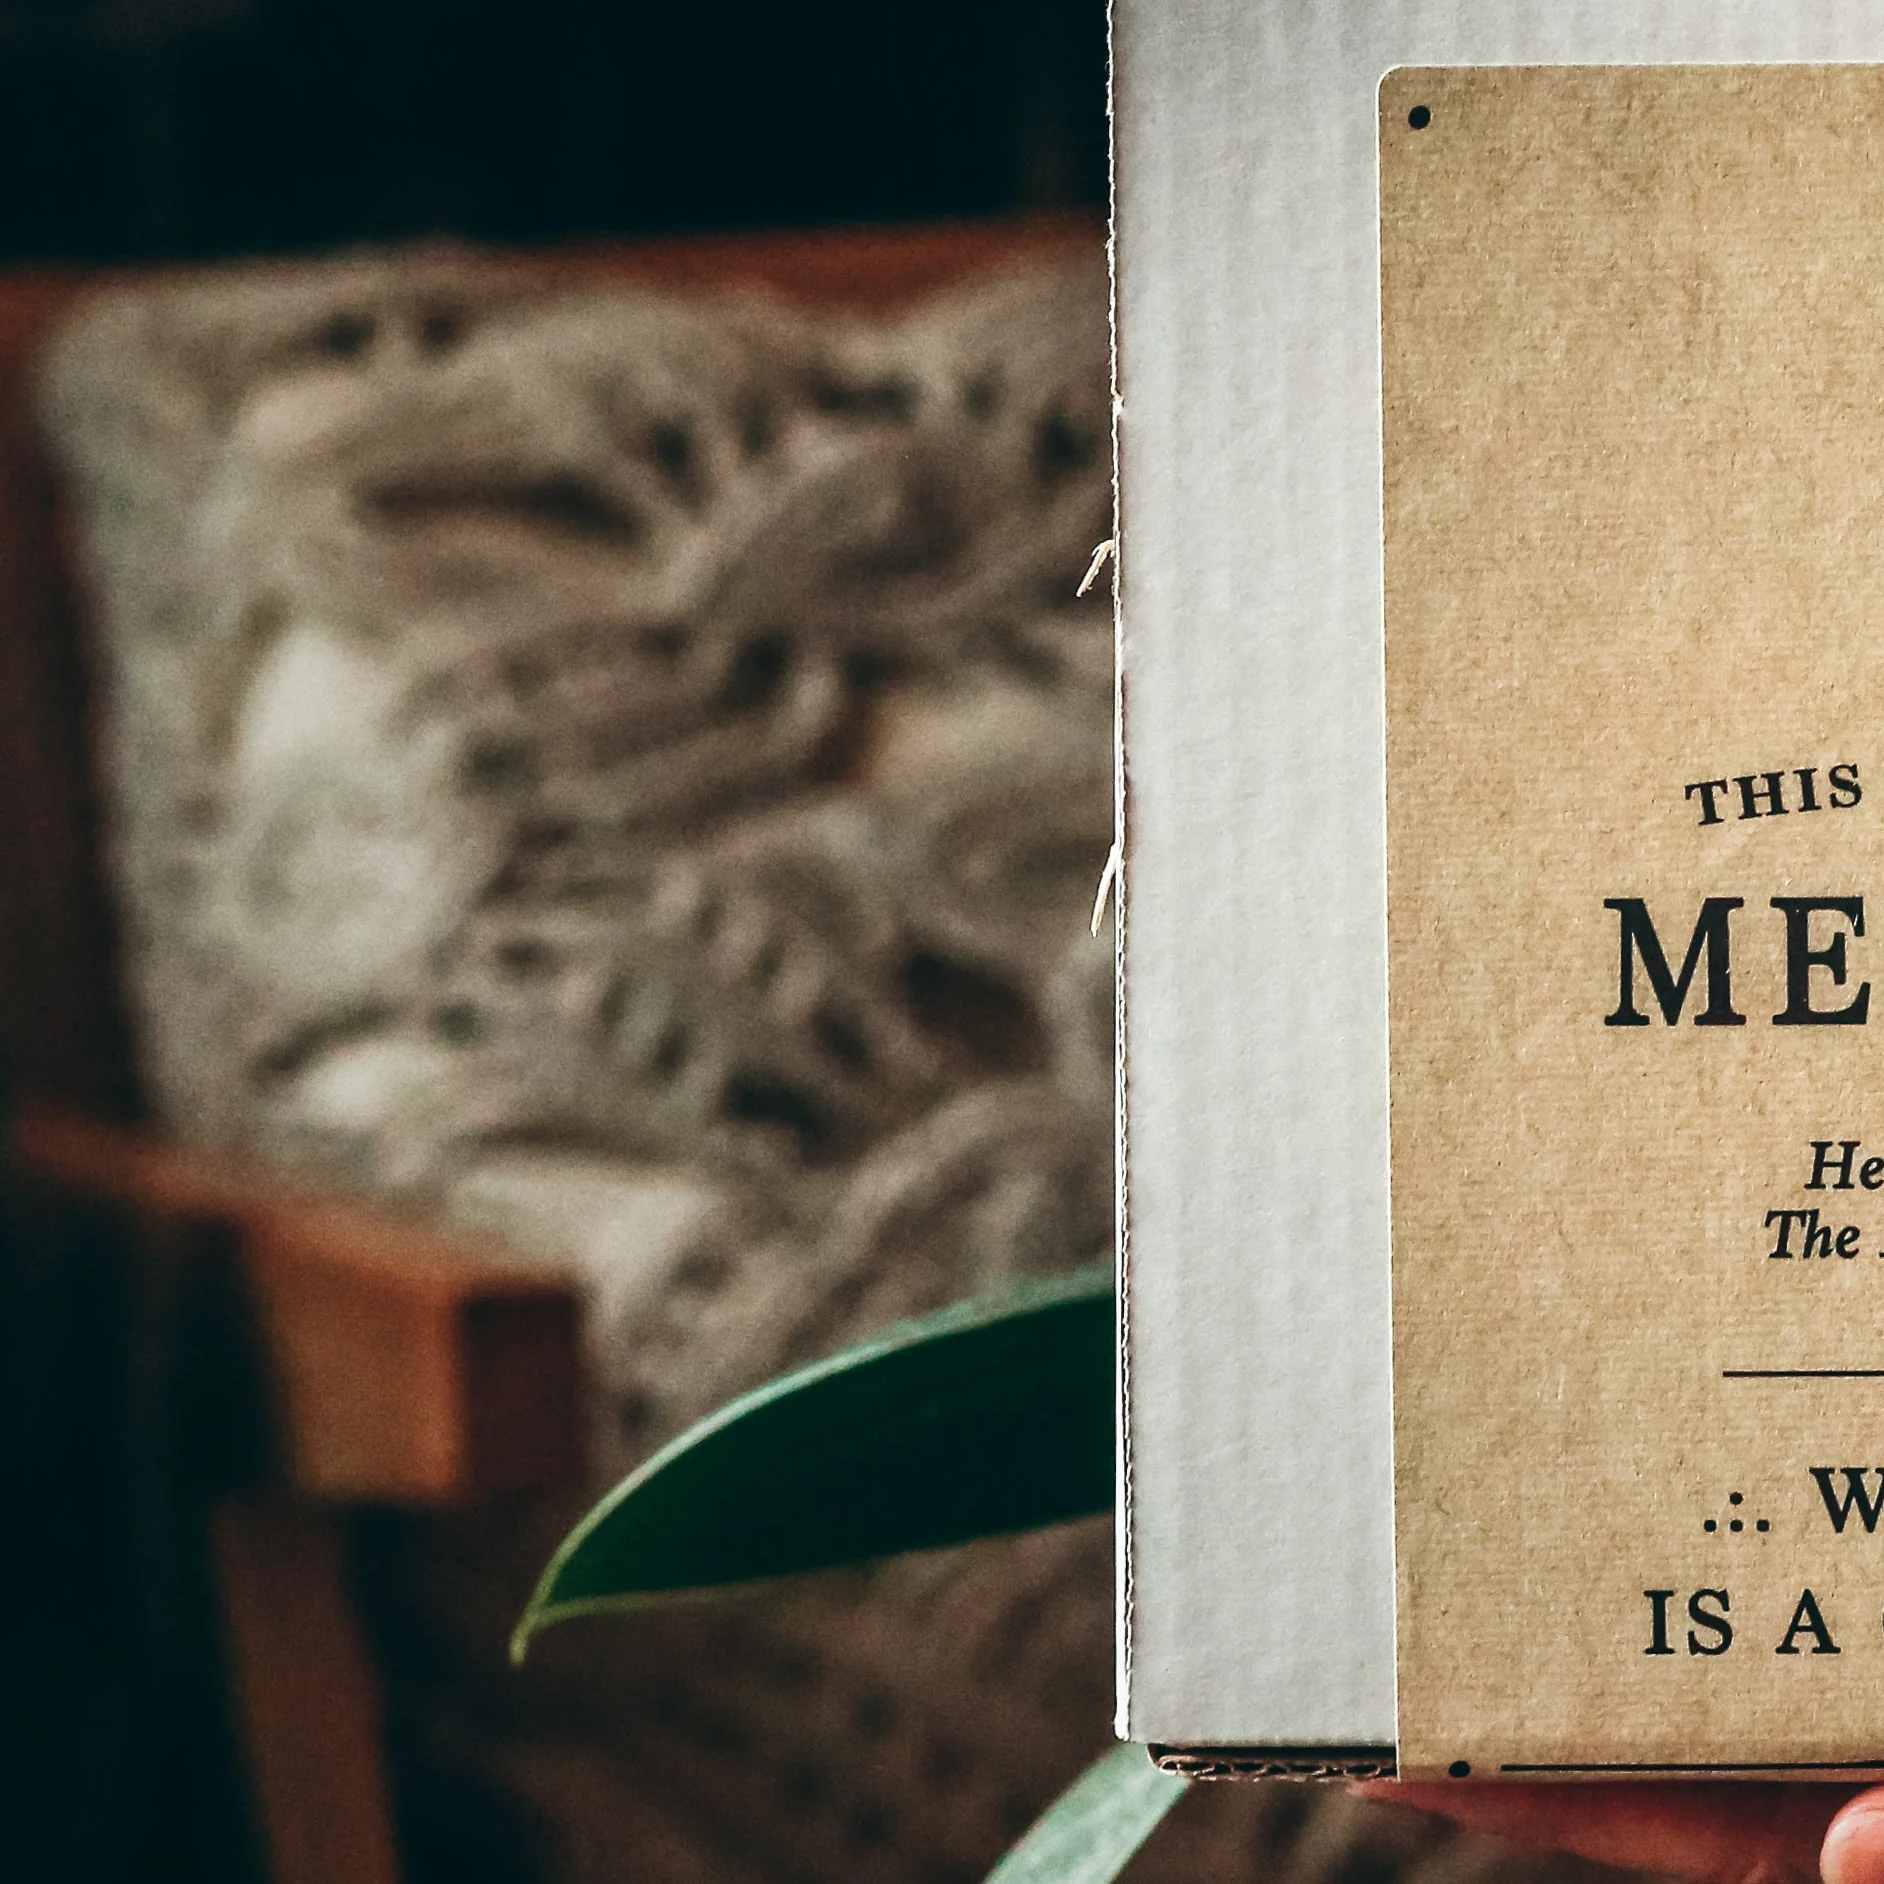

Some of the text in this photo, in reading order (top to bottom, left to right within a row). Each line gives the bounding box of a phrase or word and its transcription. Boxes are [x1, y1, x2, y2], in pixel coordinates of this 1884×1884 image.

[1683, 762, 1864, 827] THIS
[1763, 1207, 1862, 1261] The
[1642, 1587, 1735, 1657] IS
[1773, 1587, 1843, 1656] A
